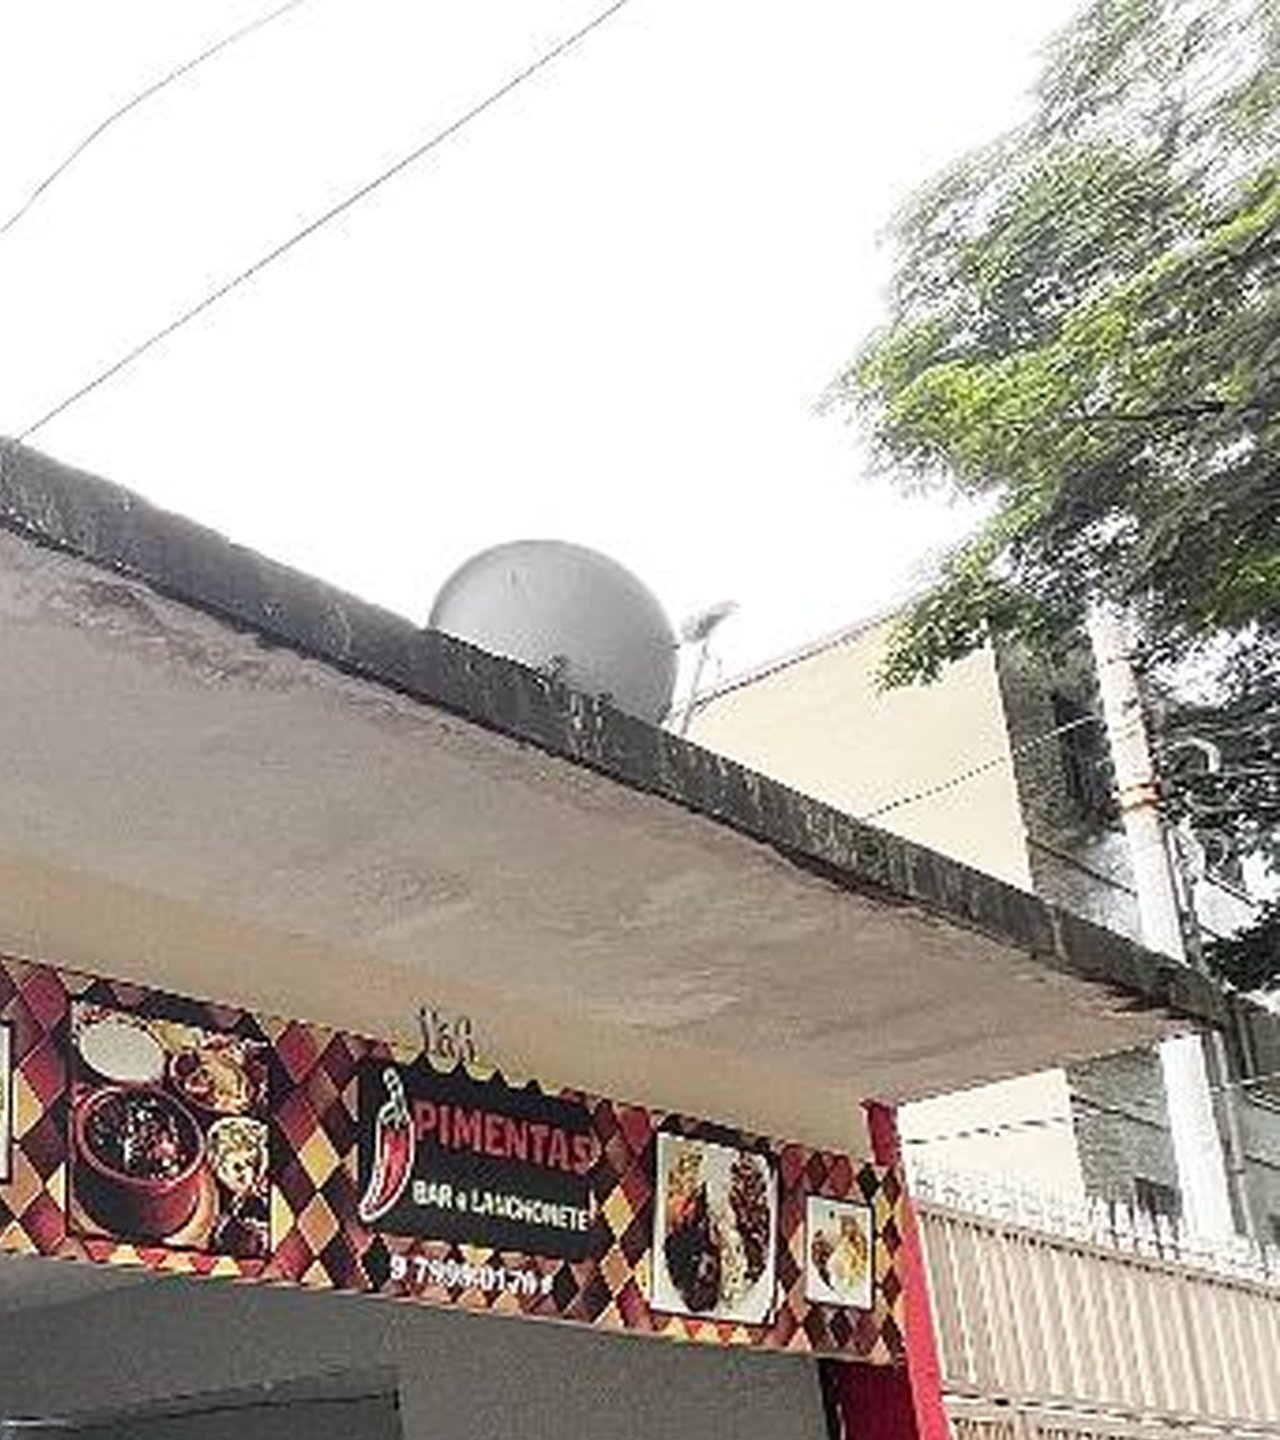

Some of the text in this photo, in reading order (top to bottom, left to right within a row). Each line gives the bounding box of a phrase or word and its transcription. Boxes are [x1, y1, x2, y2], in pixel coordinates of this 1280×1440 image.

[411, 1101, 593, 1176] PIMENTAS
[411, 1179, 453, 1209] BAR
[469, 1189, 590, 1232] LANCHONETE
